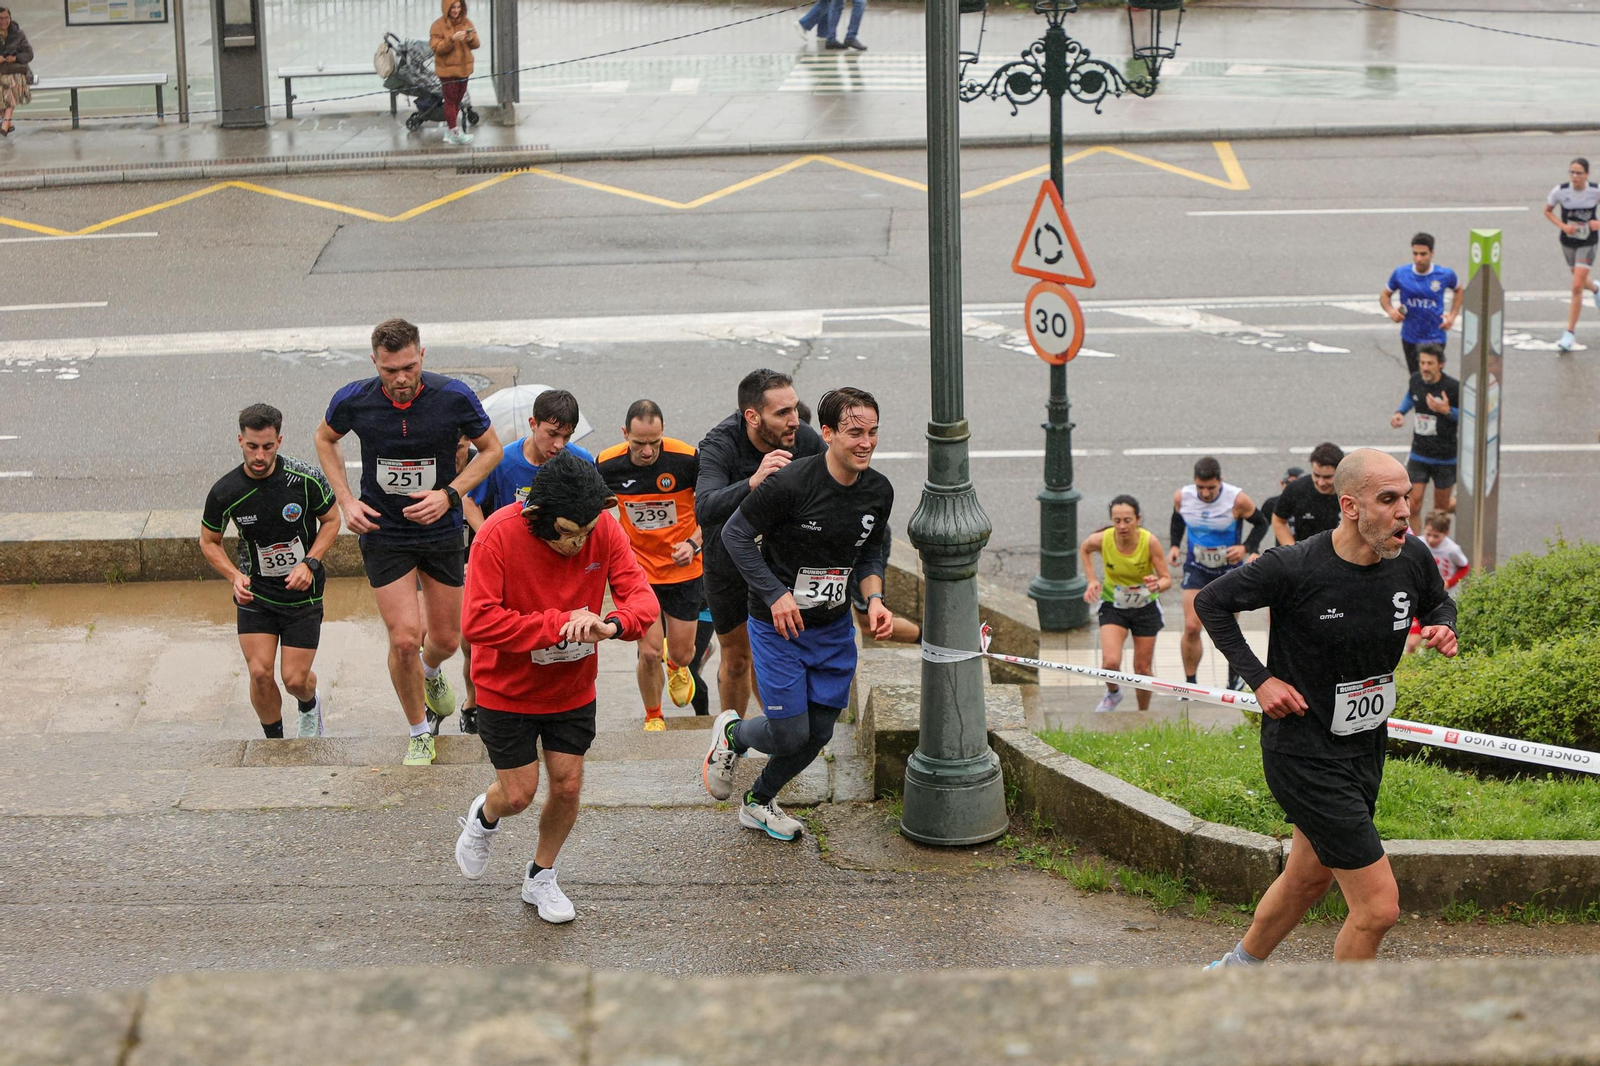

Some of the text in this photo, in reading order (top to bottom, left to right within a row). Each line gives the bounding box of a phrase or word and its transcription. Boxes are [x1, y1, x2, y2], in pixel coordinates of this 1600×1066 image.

[1036, 308, 1067, 338] 30
[387, 472, 422, 487] 251
[635, 509, 667, 522] 239
[263, 552, 297, 569] 383
[806, 581, 844, 602] 348
[1125, 593, 1141, 603] 77
[1320, 612, 1344, 620] amura
[1345, 694, 1384, 722] 200
[1464, 735, 1591, 764] CONCELLO DE VIGO
